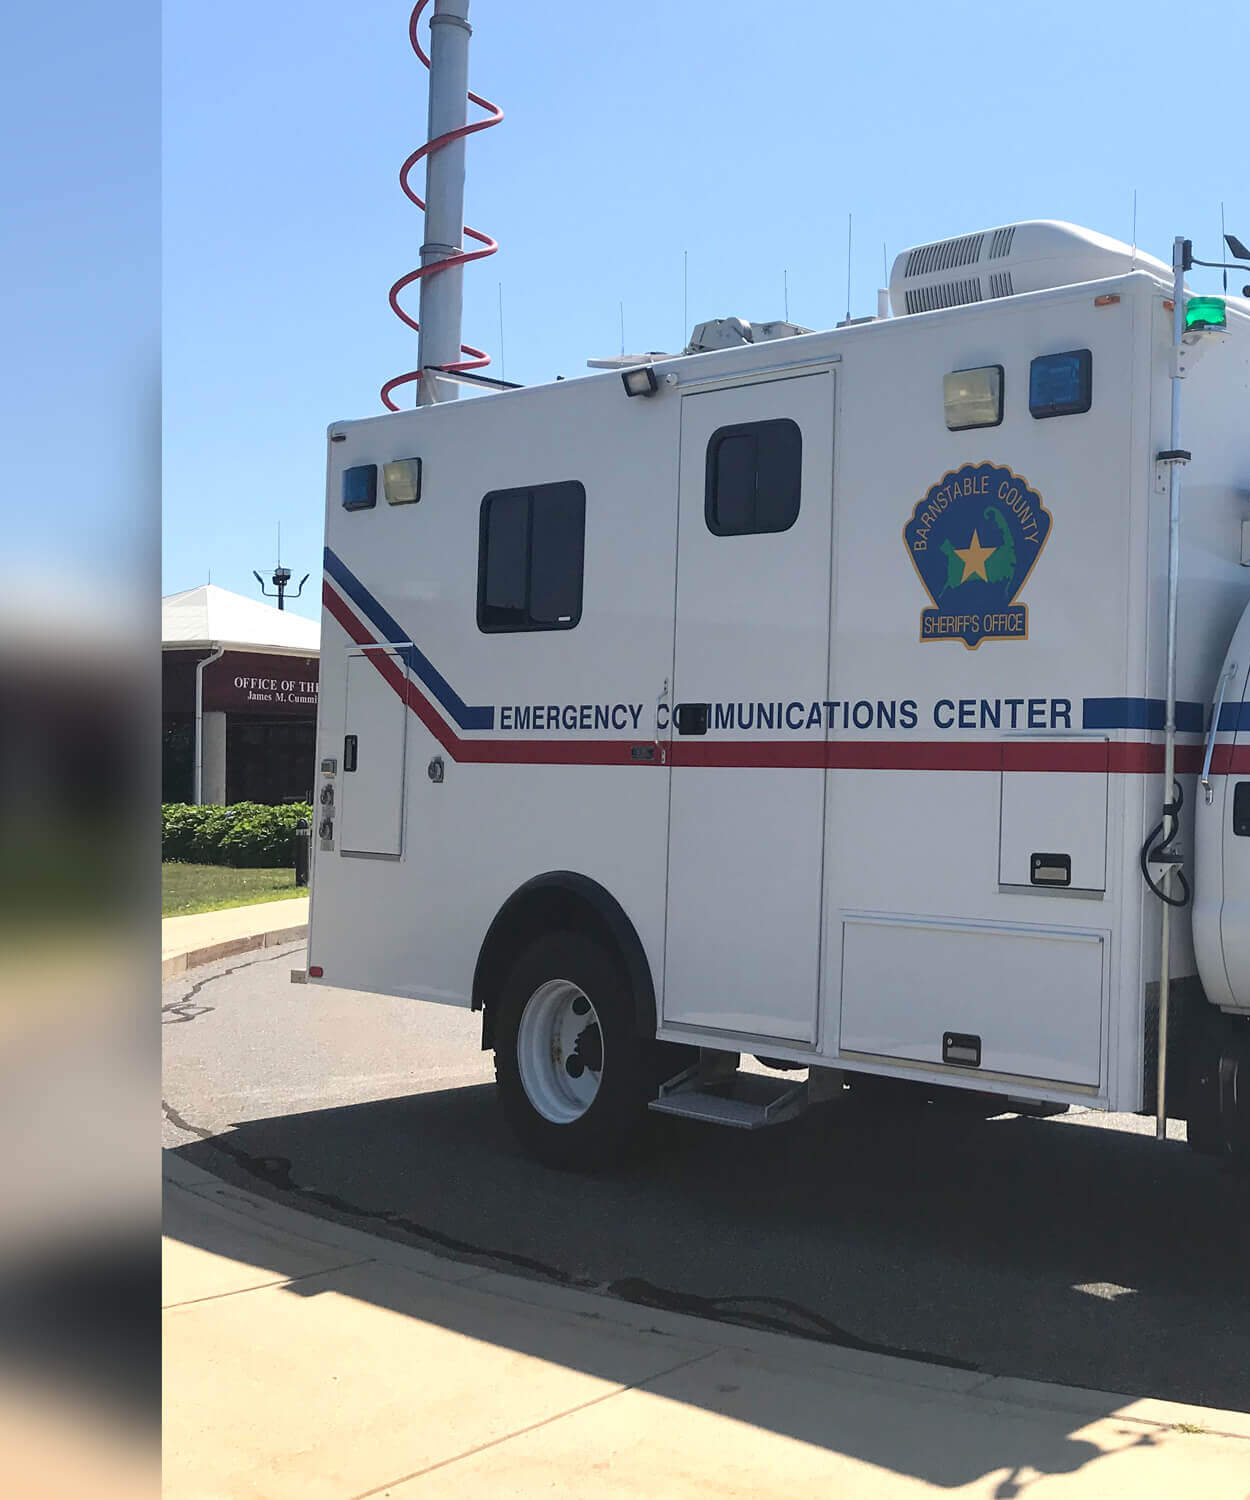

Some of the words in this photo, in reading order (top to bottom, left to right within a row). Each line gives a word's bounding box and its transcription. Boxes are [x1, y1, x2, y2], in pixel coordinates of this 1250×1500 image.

[914, 475, 990, 551] BARNSTABLE
[998, 481, 1040, 544] COUNTY
[924, 615, 980, 634] SHERIFF'S
[983, 613, 1023, 632] OFFICE
[234, 676, 277, 690] OFFICE
[281, 680, 295, 691] OF
[247, 690, 272, 701] James
[275, 692, 286, 702] M.
[288, 693, 319, 704] Cummi
[500, 703, 643, 730] EMERGENCY
[656, 700, 918, 730] CMUNICATIONS
[933, 698, 1072, 729] CENTER
